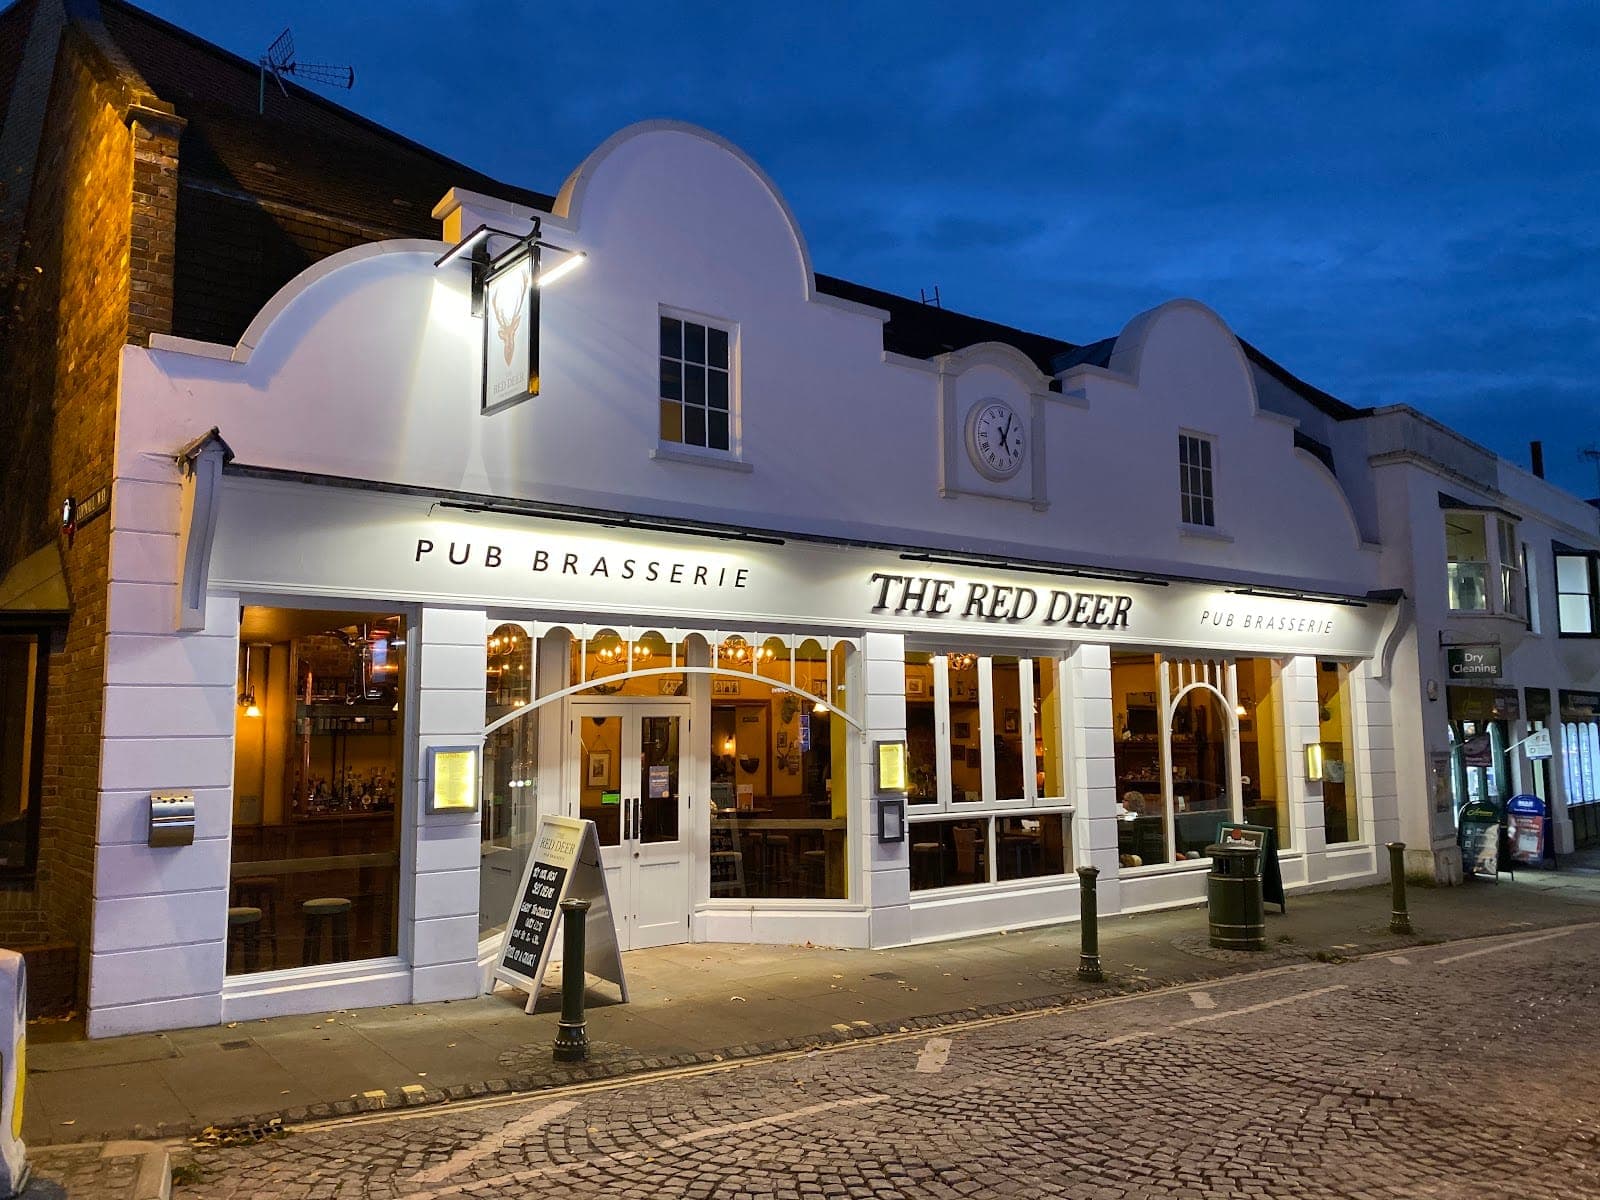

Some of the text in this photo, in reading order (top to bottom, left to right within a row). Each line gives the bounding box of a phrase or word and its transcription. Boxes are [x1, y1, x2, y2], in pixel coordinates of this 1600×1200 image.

[415, 539, 749, 588] PUB BRASSERIE
[871, 572, 1133, 627] THE RED DEER
[1200, 610, 1333, 634] PUB BRASSERIE
[1464, 653, 1484, 663] Dry
[1452, 664, 1497, 674] Cleaning
[540, 837, 576, 855] RED DEER
